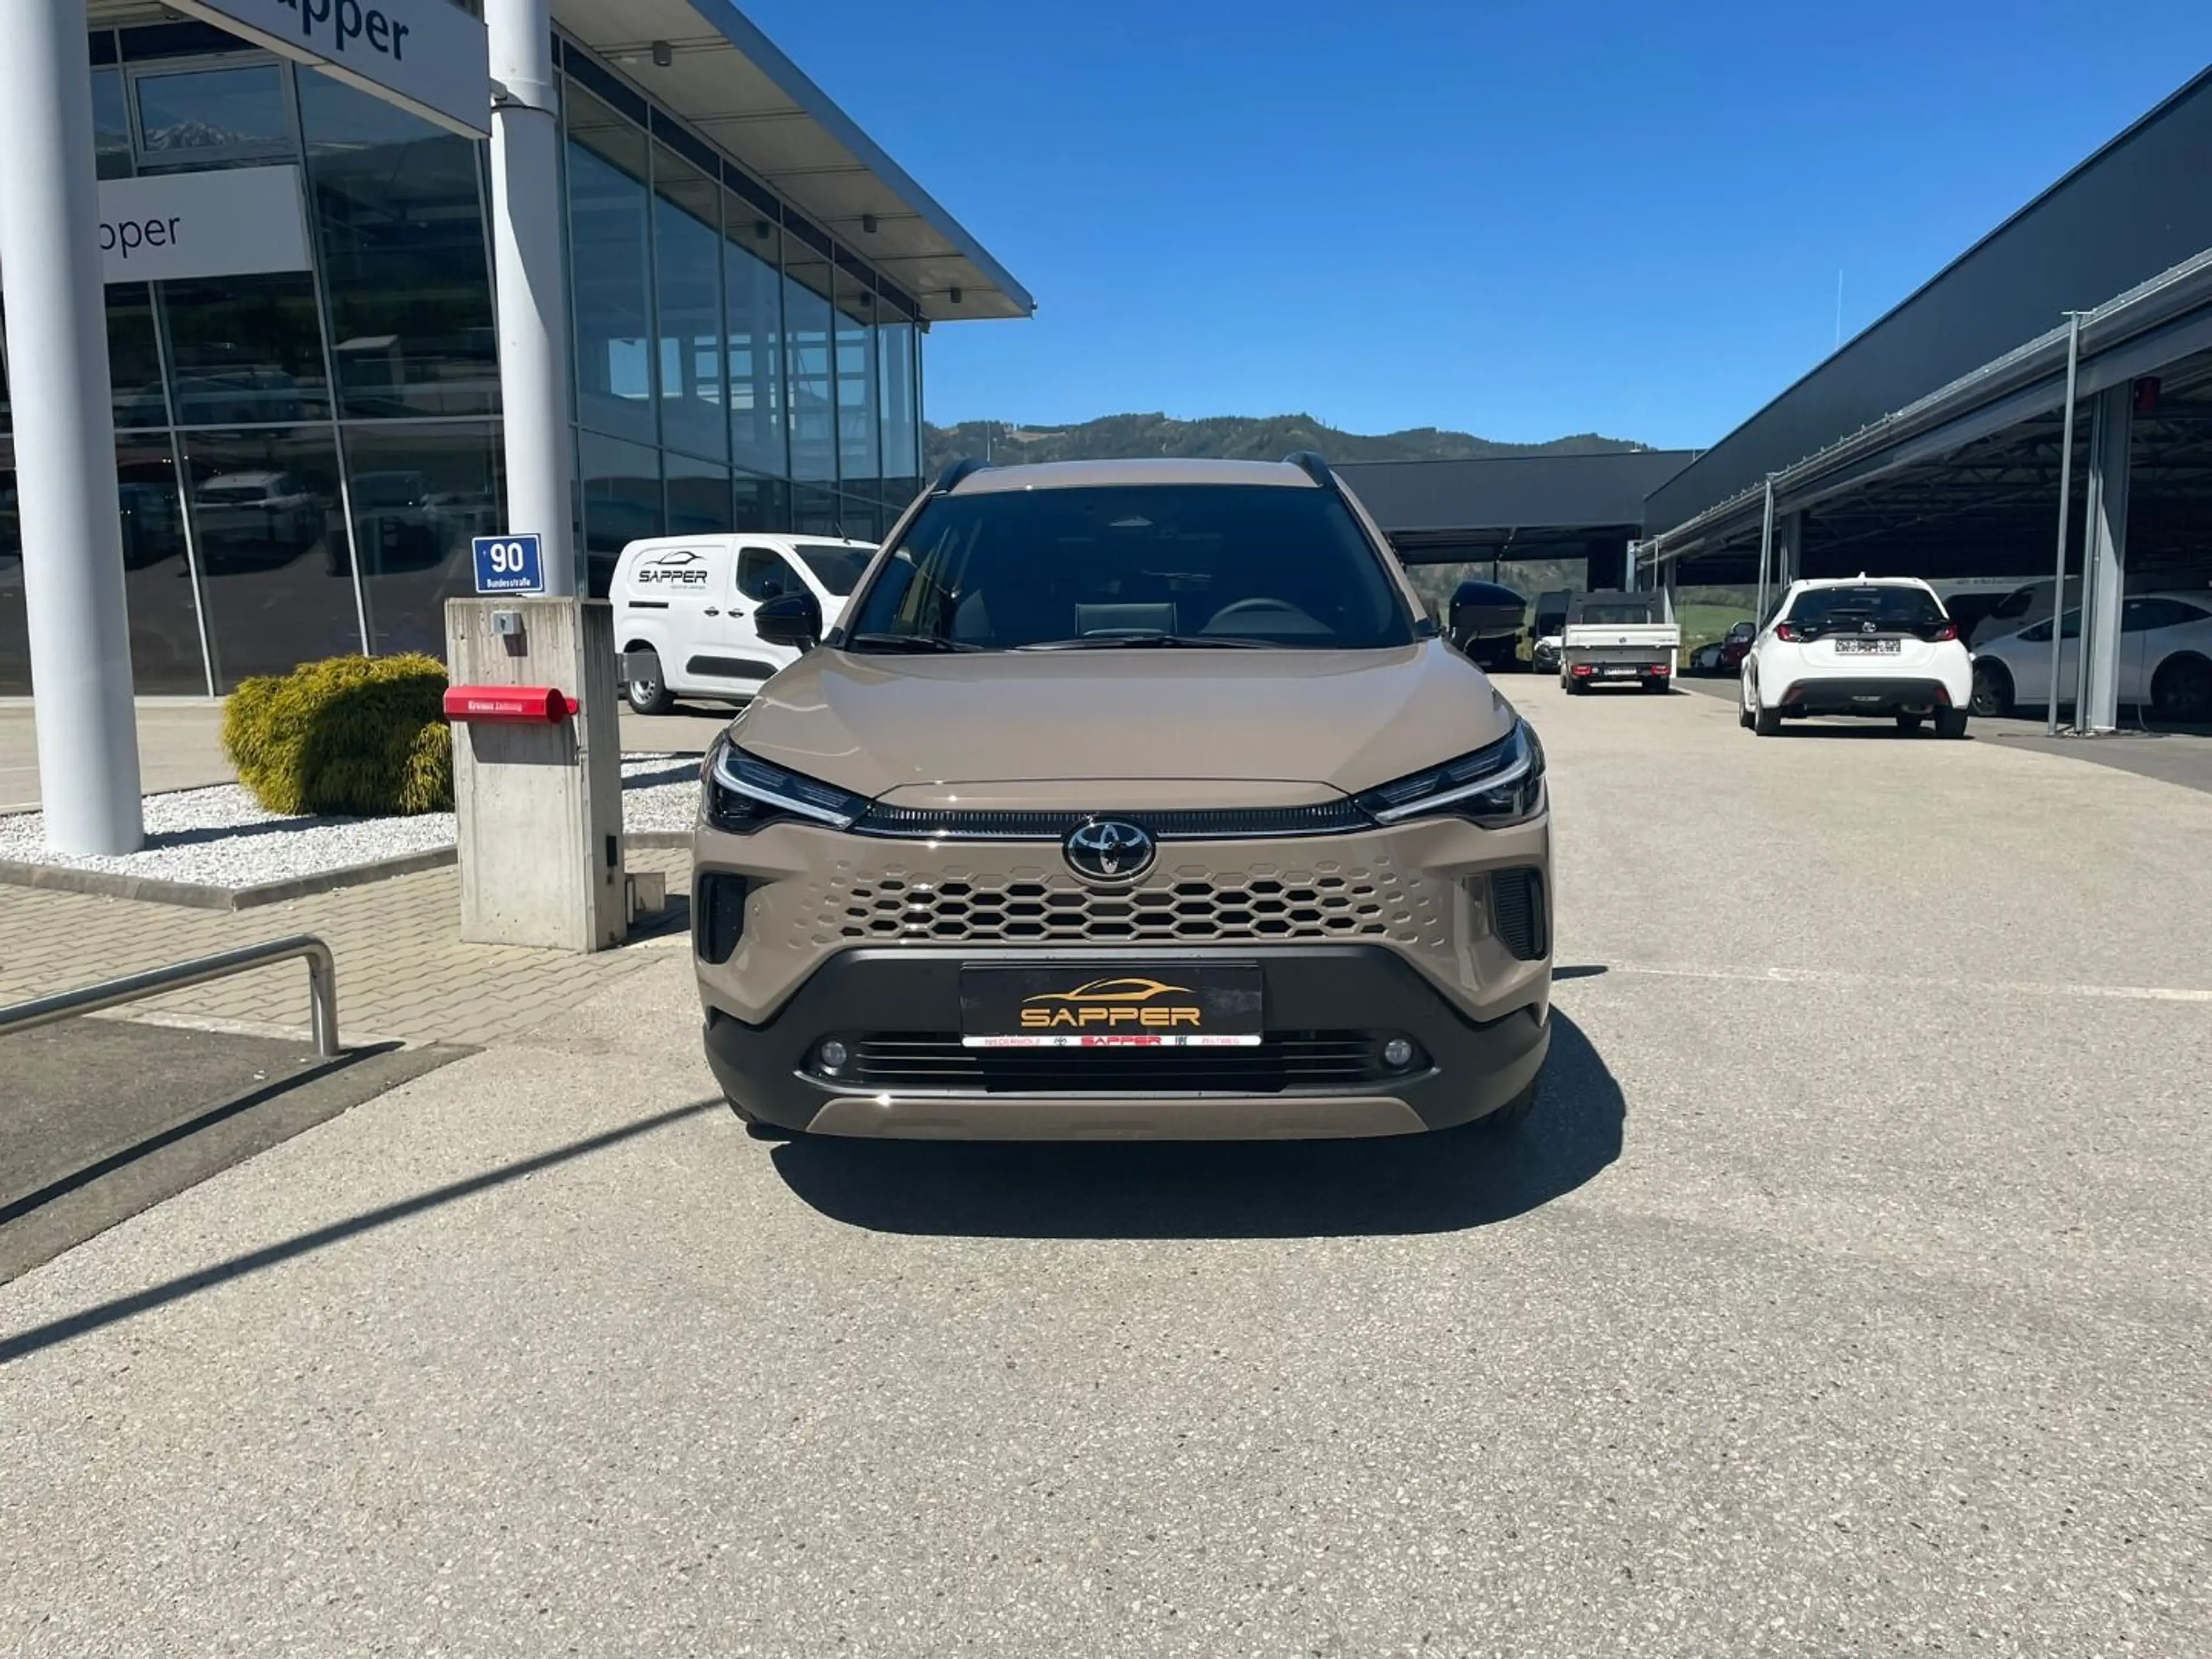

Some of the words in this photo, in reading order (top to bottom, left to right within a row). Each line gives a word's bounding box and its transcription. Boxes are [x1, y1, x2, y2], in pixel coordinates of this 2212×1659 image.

[276, 0, 410, 61] pper
[490, 542, 524, 573] 90
[639, 570, 707, 583] SAPPER
[1021, 1007, 1200, 1027] SAPPER
[1081, 1036, 1162, 1046] SAPPER
